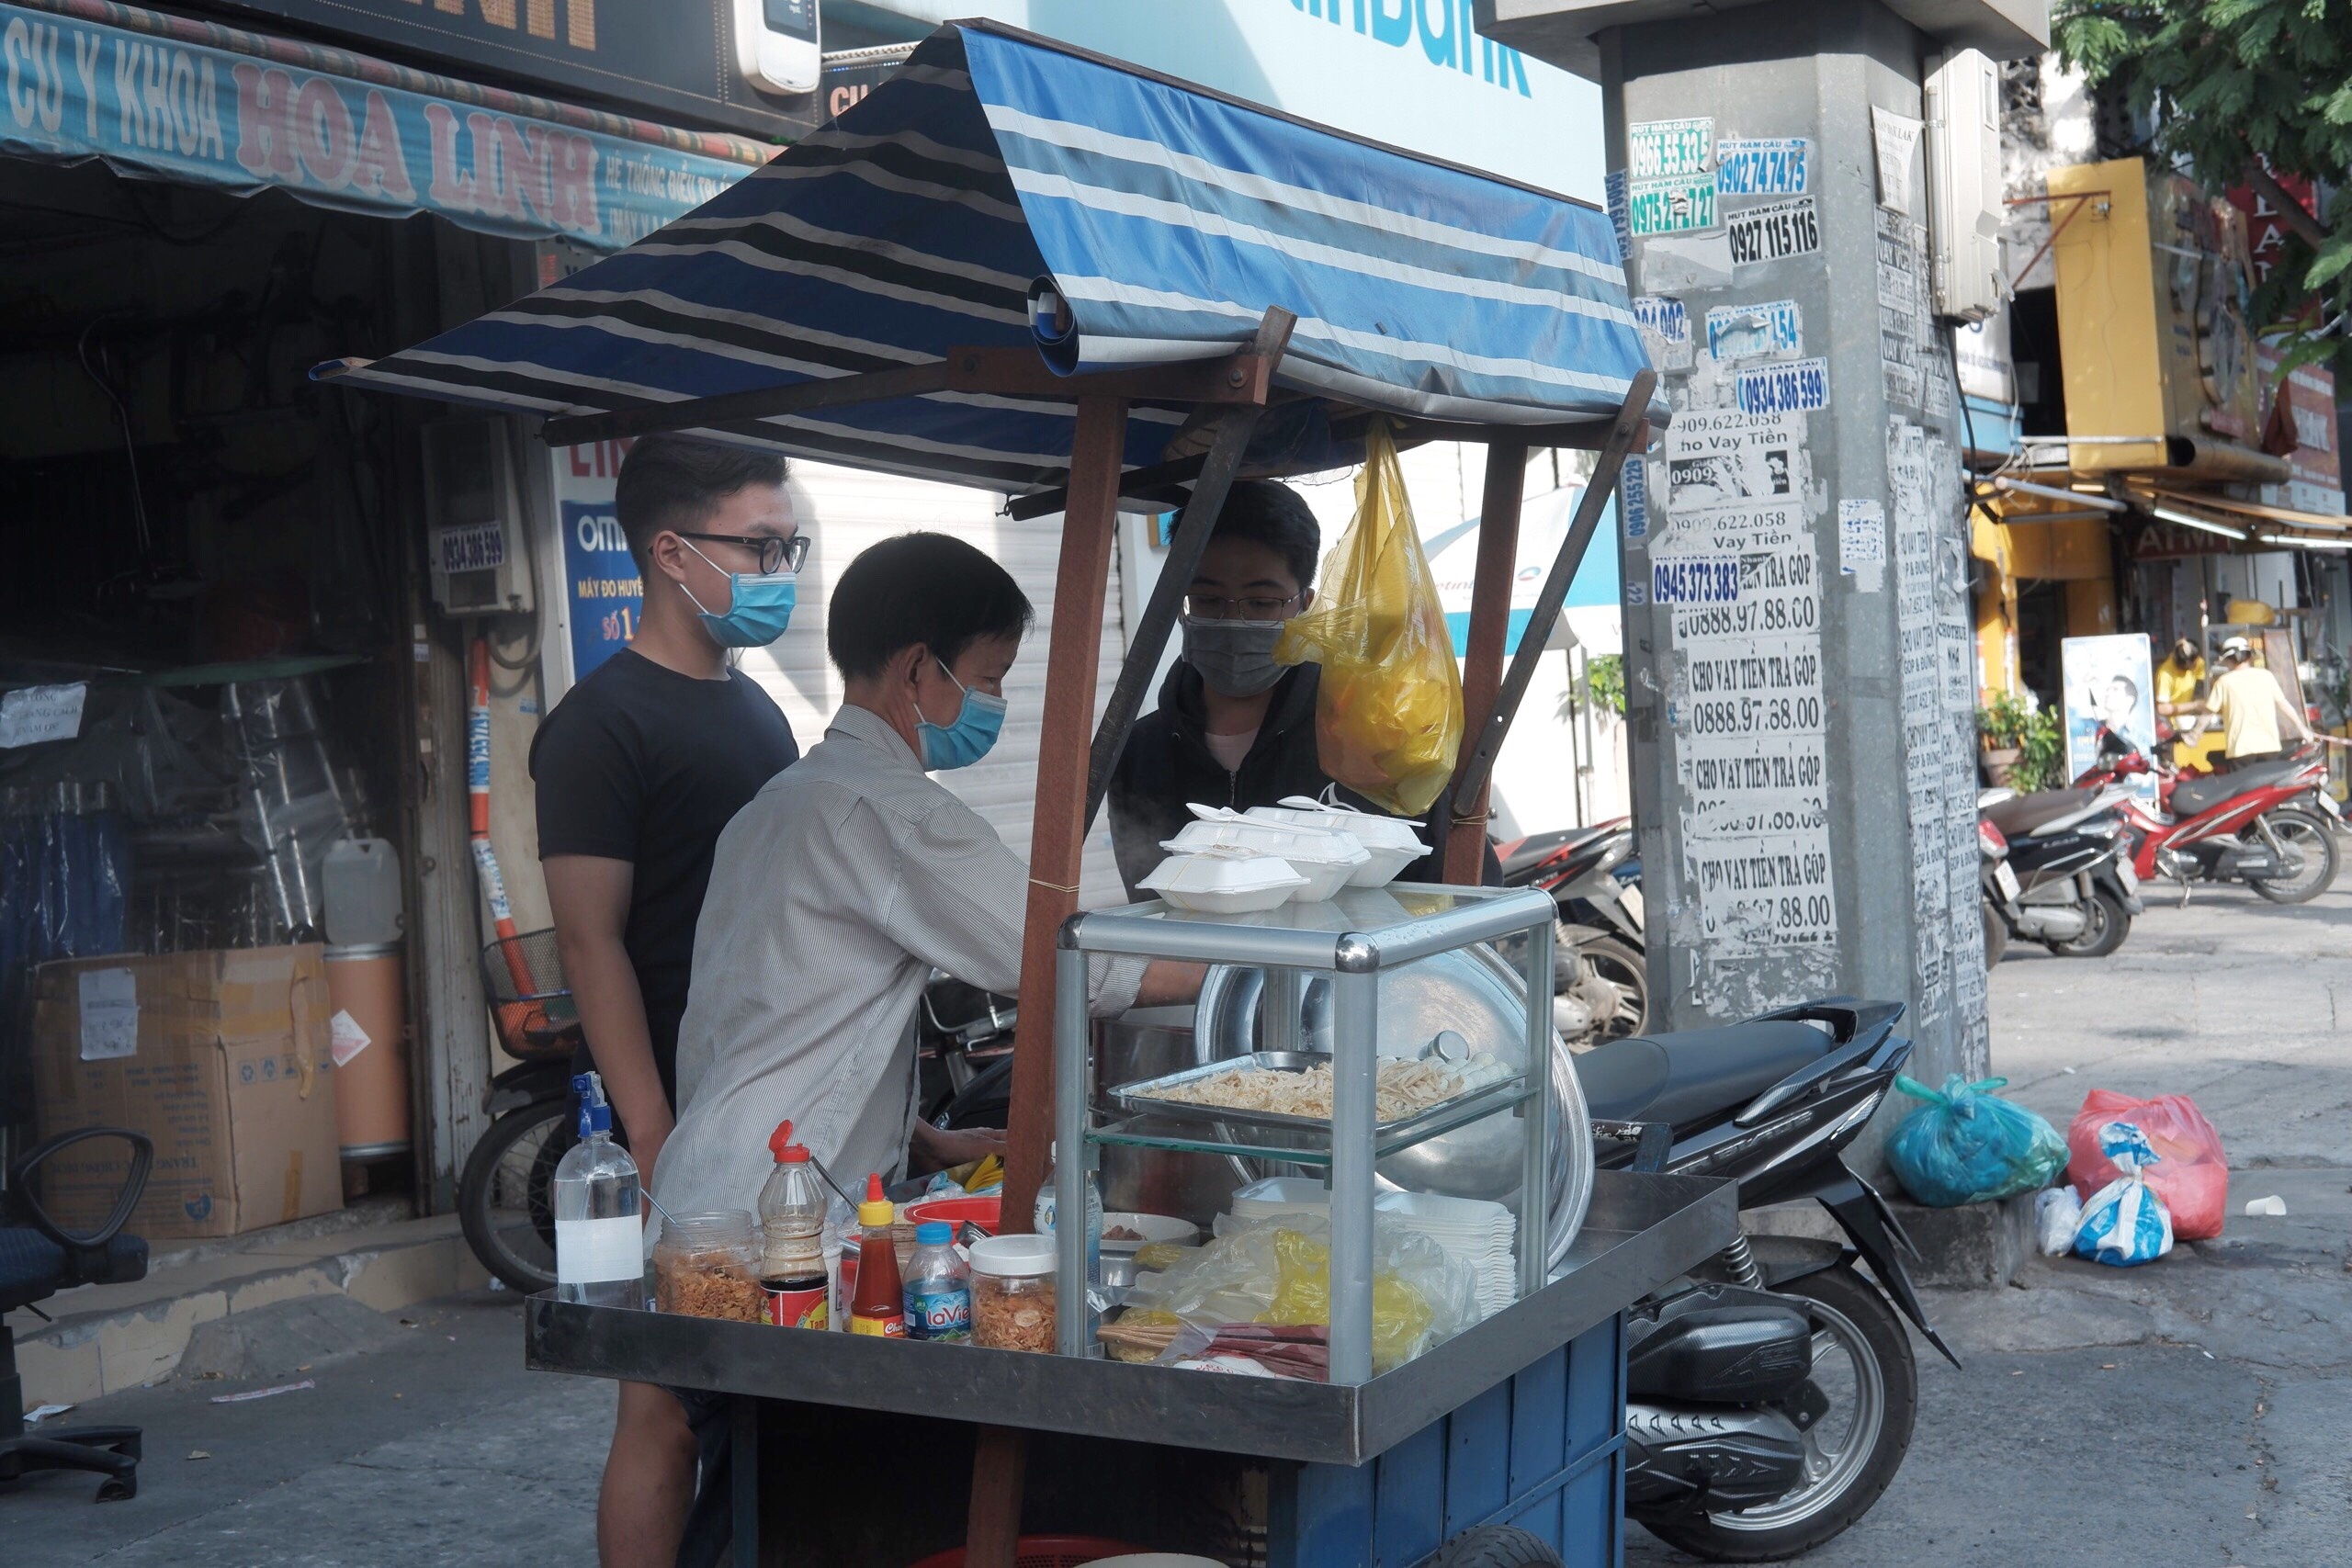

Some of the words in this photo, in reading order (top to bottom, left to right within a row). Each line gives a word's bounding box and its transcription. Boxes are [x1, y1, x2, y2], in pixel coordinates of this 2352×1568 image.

[74, 30, 100, 138] Y
[116, 39, 223, 160] KHOA
[232, 62, 416, 202] HOA
[424, 103, 602, 236] LINH
[627, 153, 666, 198] THỐNG
[668, 160, 697, 205] ĐIỀU
[1745, 368, 1823, 415] 0934.386.599
[1678, 438, 1702, 453] ho
[1709, 435, 1742, 450] Vay
[1747, 428, 1788, 446] Tiền
[1713, 536, 1747, 551] Vay
[1751, 528, 1792, 547] Tiền
[578, 576, 599, 599] MÁY
[601, 581, 616, 598] ĐO
[1655, 561, 1738, 604] 0945.373.383
[603, 609, 620, 641] SỐ
[621, 605, 634, 641] 1
[1692, 660, 1713, 693] CHO
[1714, 659, 1738, 692] VAY
[1739, 639, 1767, 690] TIỀN
[1768, 641, 1792, 689] TRẢ
[1793, 645, 1817, 687] GÓP
[1694, 695, 1820, 735] 0888.97.88.00
[1696, 758, 1717, 791] CHO
[1719, 757, 1742, 790] VAY
[1744, 739, 1771, 790] TIỀN
[1772, 740, 1796, 788] TRẢ
[1798, 745, 1821, 787] GÓP
[1724, 858, 1747, 890] VAY
[1748, 840, 1776, 889] TIỀN
[1778, 840, 1802, 887] TRẢ
[1804, 843, 1826, 886] GÓP
[926, 1304, 970, 1326] laVie
